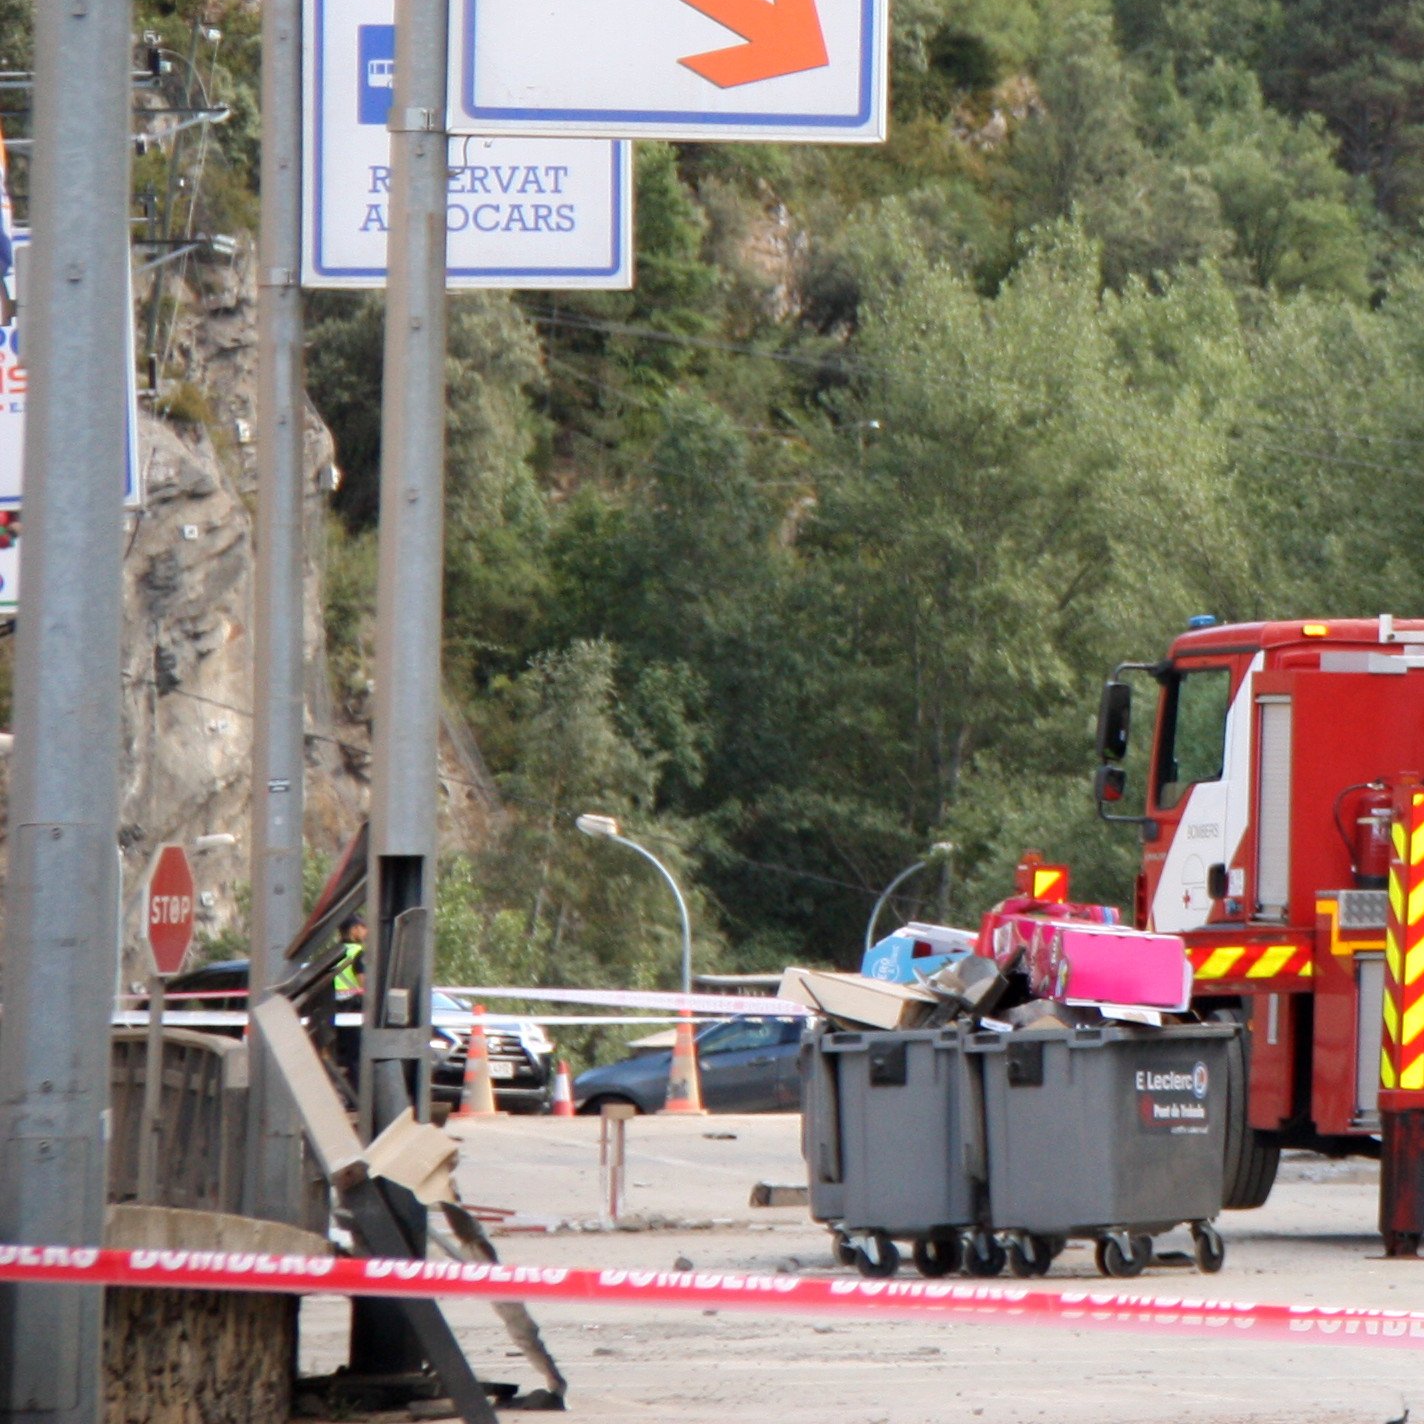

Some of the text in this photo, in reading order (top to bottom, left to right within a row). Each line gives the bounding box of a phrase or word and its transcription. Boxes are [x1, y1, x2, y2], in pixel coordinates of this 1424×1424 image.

[368, 165, 568, 194] RERVAT
[359, 203, 576, 232] AOCARS
[151, 895, 191, 924] STOP
